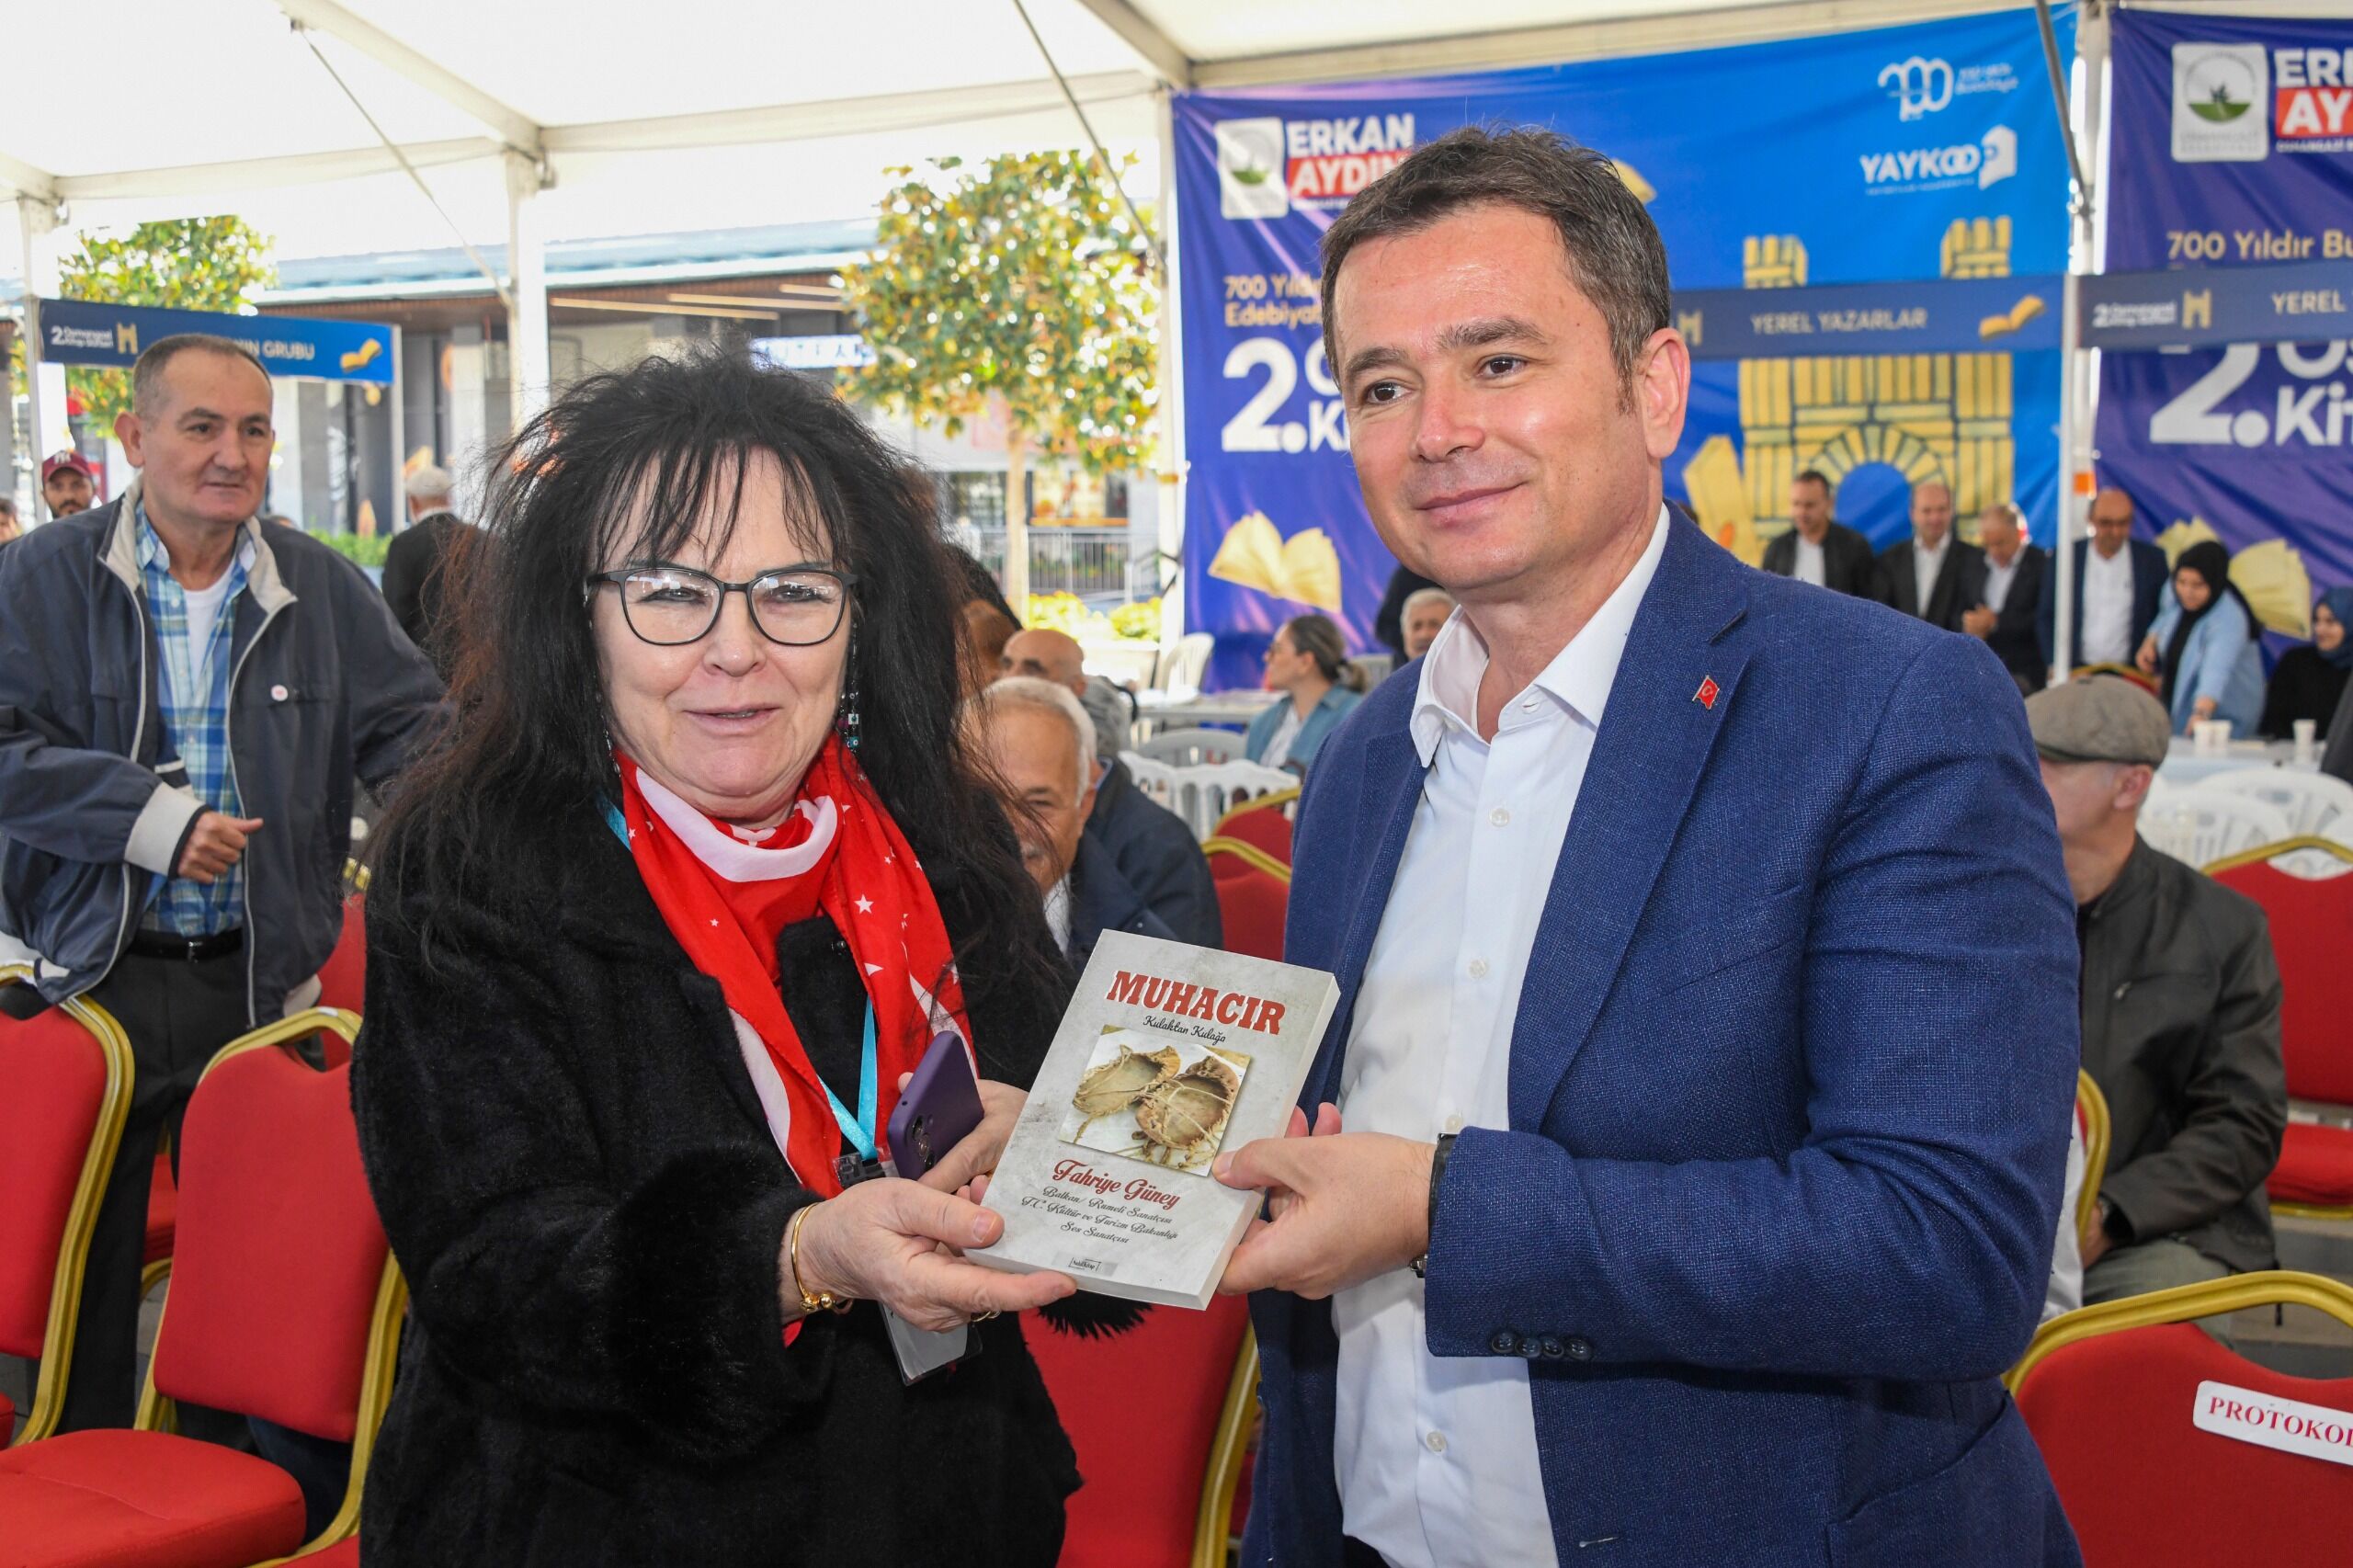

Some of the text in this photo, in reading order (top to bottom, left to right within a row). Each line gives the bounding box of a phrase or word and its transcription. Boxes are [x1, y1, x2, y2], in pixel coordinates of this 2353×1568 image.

[2274, 48, 2353, 88] ER
[2281, 89, 2353, 135] AY
[1286, 113, 1415, 156] ERKAN
[2166, 231, 2226, 260] 700
[2234, 228, 2315, 259] Yıldır
[1223, 273, 1322, 299] 700 Yıldı
[2272, 290, 2346, 314] YEREL
[1750, 307, 1929, 335] YEREL YAZARLAR
[263, 339, 315, 361] GRUBU
[1222, 336, 1308, 454] 2.
[1106, 970, 1286, 1035] MUHACIR
[1142, 1015, 1226, 1046] Kulaktan Kulağa
[1052, 1159, 1180, 1210] Fahriye Güney
[1047, 1201, 1082, 1218] Kültür
[1083, 1212, 1094, 1221] ve
[1095, 1214, 1129, 1230] Turizm
[1131, 1222, 1179, 1241] Bakanlığı
[1088, 1198, 1127, 1214] Rumeli
[1126, 1207, 1174, 1224] Sanatçısı
[1061, 1221, 1131, 1244] Ses Sanatçısı
